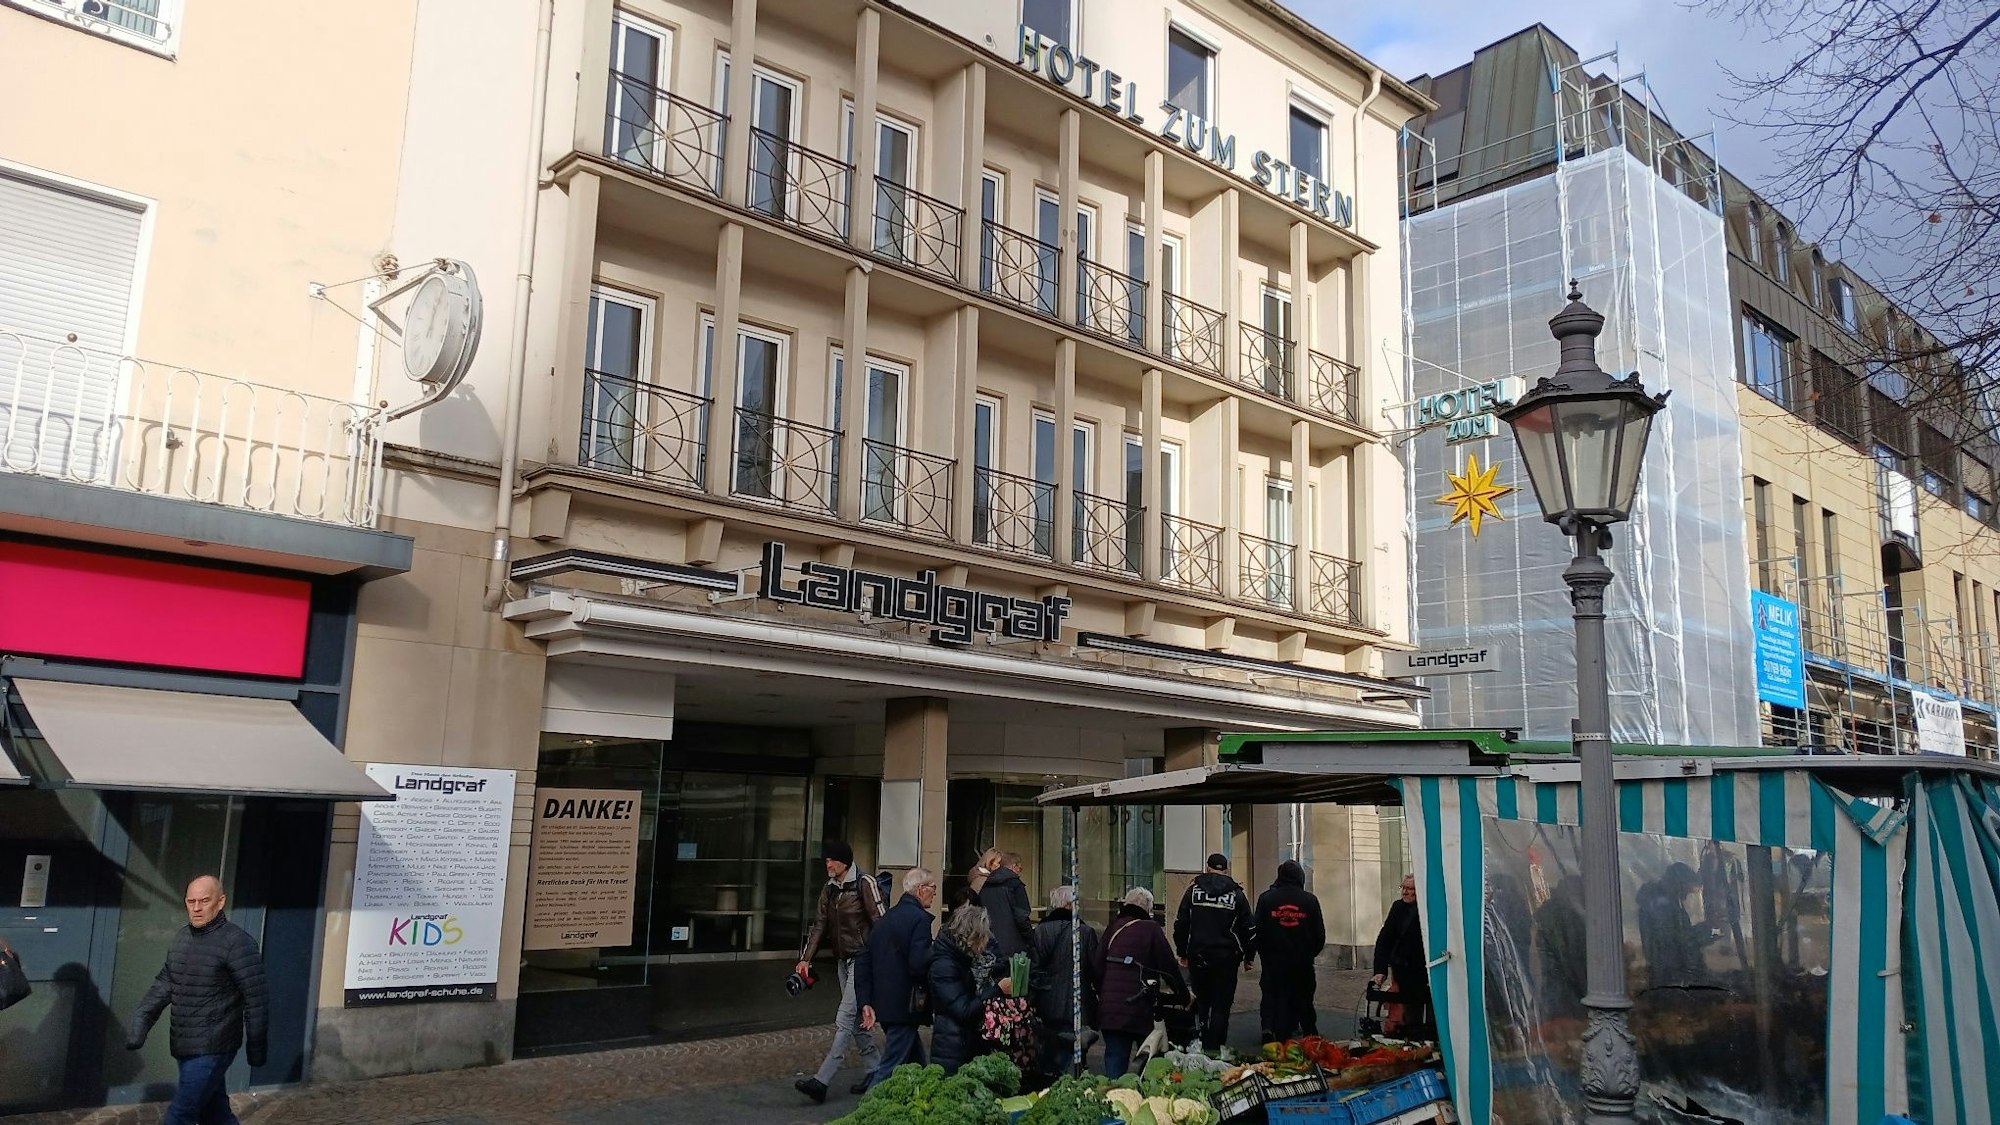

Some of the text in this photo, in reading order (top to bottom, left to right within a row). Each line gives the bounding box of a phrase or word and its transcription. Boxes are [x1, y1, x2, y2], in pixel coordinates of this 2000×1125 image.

[1018, 24, 1352, 228] HOTEL ZUM STERN
[1418, 380, 1511, 424] HOTEL
[1446, 415, 1490, 442] ZUM
[761, 541, 1072, 645] Landgraf
[1768, 604, 1793, 627] MELIK
[1408, 650, 1487, 668] Landgraf
[395, 775, 487, 794] Landgraf
[543, 798, 634, 820] DANKE!
[410, 913, 448, 921] Landgraf
[389, 917, 463, 946] KIDS
[561, 931, 598, 940] Landgraf
[359, 987, 484, 1001] www.landgraf-schuhe.de
